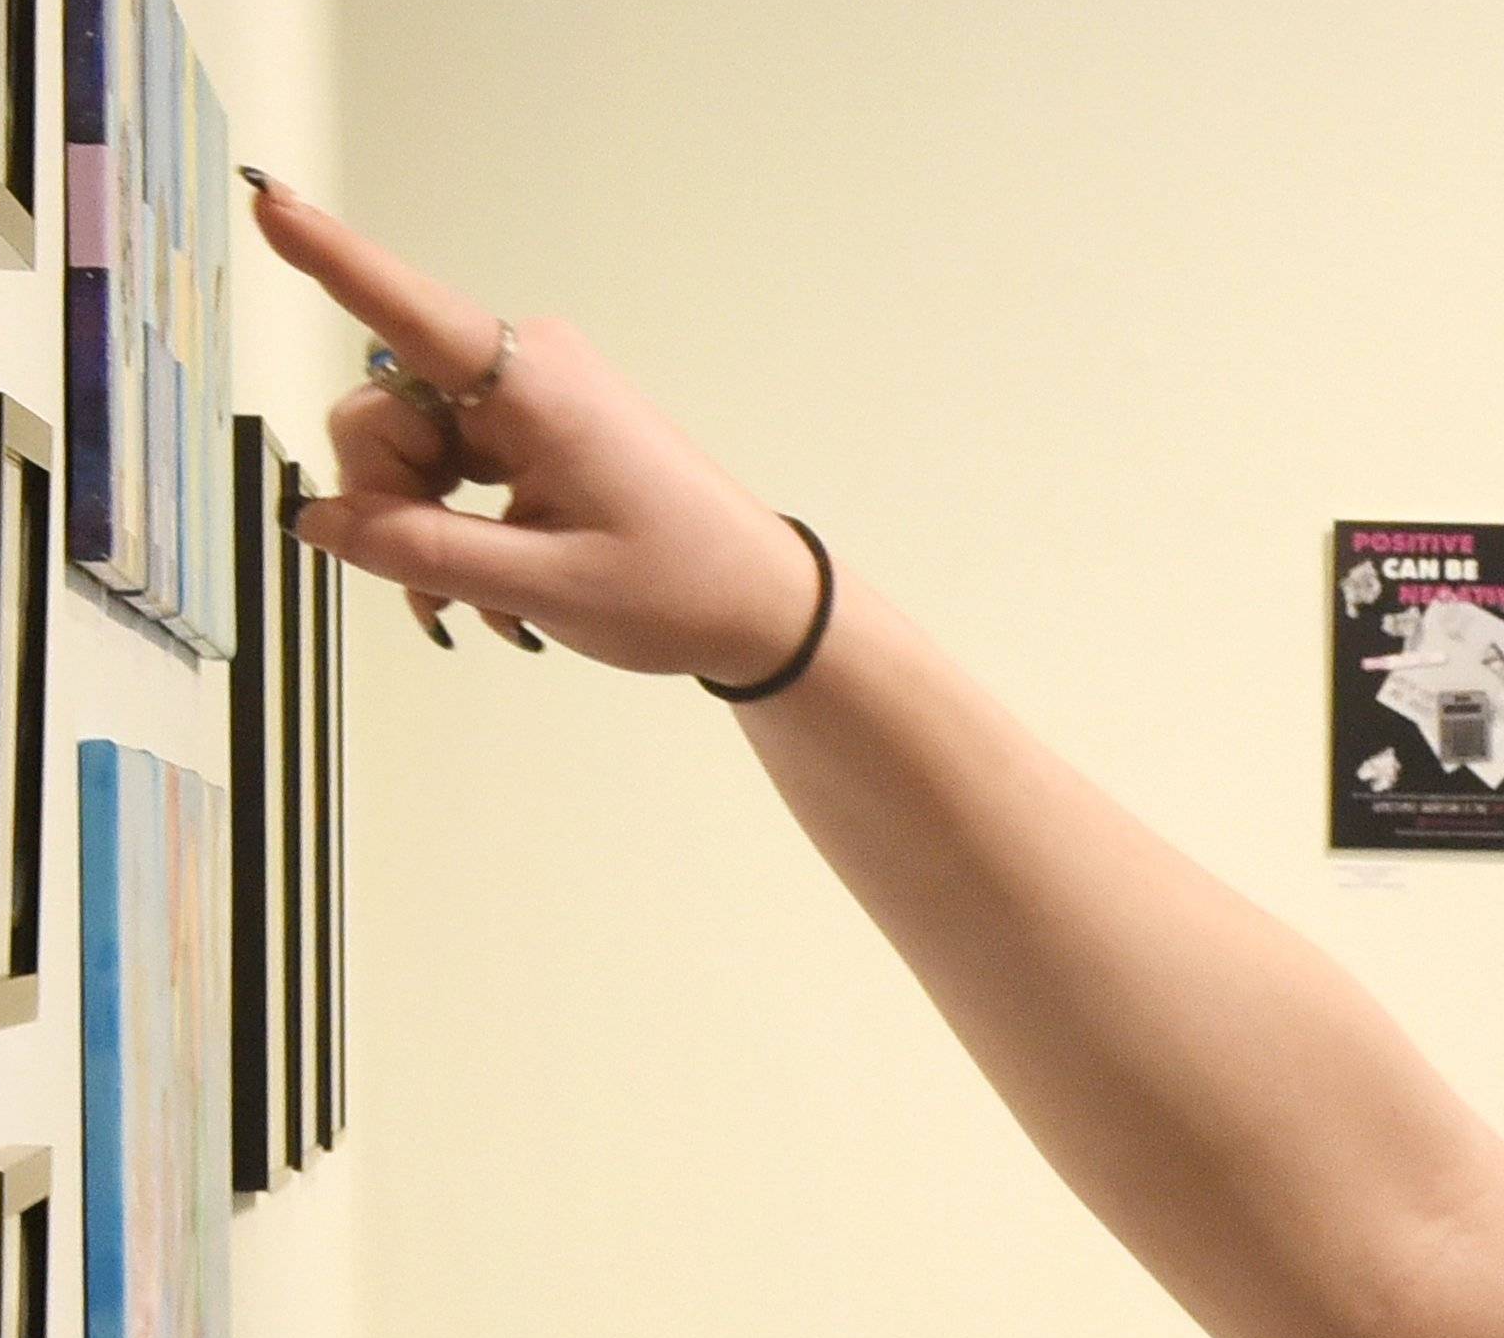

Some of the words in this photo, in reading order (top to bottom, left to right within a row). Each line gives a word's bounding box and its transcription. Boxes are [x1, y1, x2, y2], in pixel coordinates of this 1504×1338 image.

[1352, 532, 1475, 553] POSITIVE
[1382, 558, 1440, 580] CAN
[1445, 558, 1479, 581] BE
